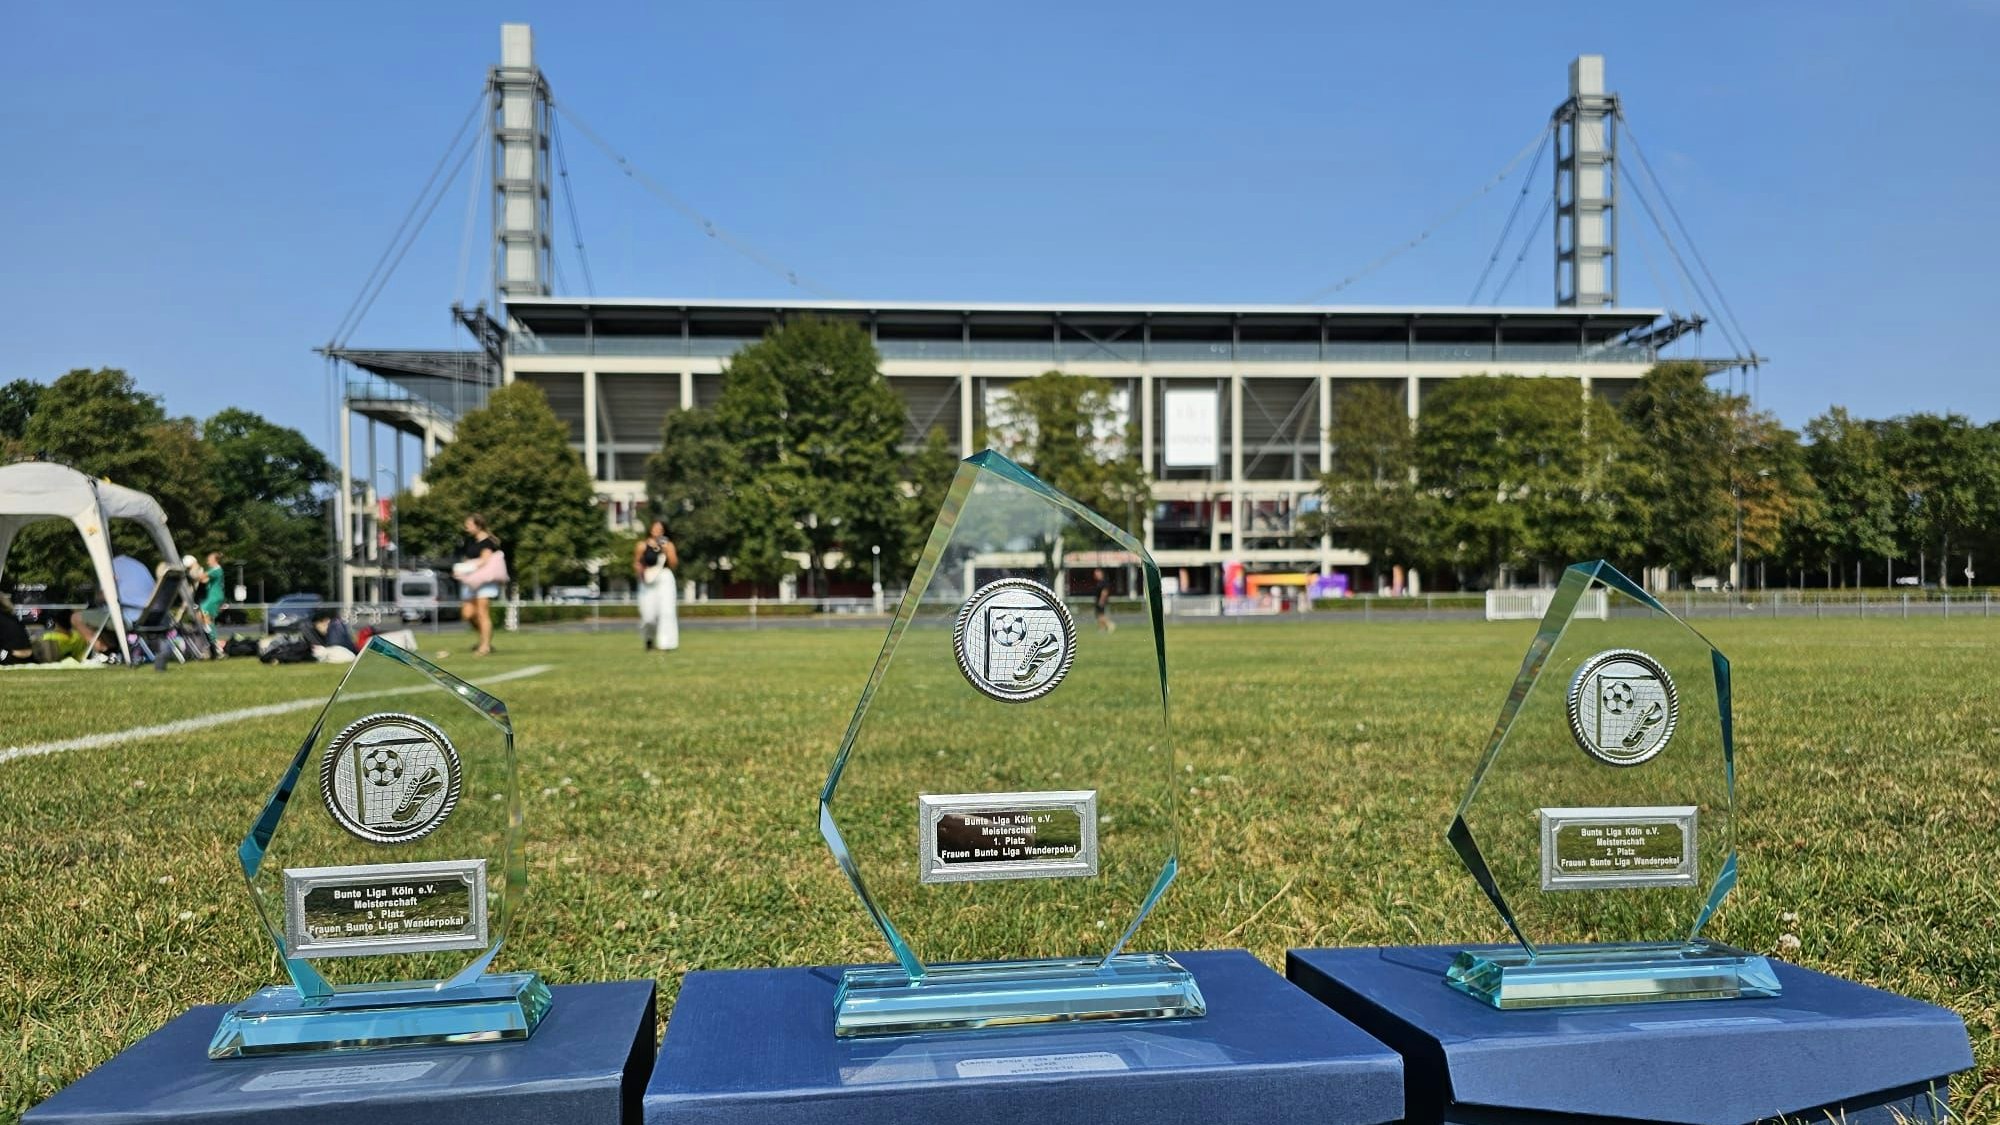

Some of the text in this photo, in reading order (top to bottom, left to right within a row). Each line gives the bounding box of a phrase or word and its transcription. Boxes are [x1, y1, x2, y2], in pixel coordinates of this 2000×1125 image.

[965, 817, 988, 825] Bunte
[993, 816, 1010, 825] Liga
[1015, 815, 1033, 824] Köln
[982, 826, 1036, 835] Meisterschaft
[1606, 828, 1621, 837] Liga
[1005, 837, 1025, 845] Platz
[1597, 838, 1645, 846] Meisterschaft
[942, 845, 1076, 858] Frauen Bunte Liga Wanderpokal
[1615, 858, 1630, 866] Liga
[1634, 856, 1679, 866] Wanderpokal
[334, 885, 436, 899] Bunte Liga Köln e.V.
[354, 898, 417, 909] Meisterschaft
[368, 910, 404, 919] 3. Platz
[309, 917, 463, 934] Frauen Bunte Liga Wanderpokal
